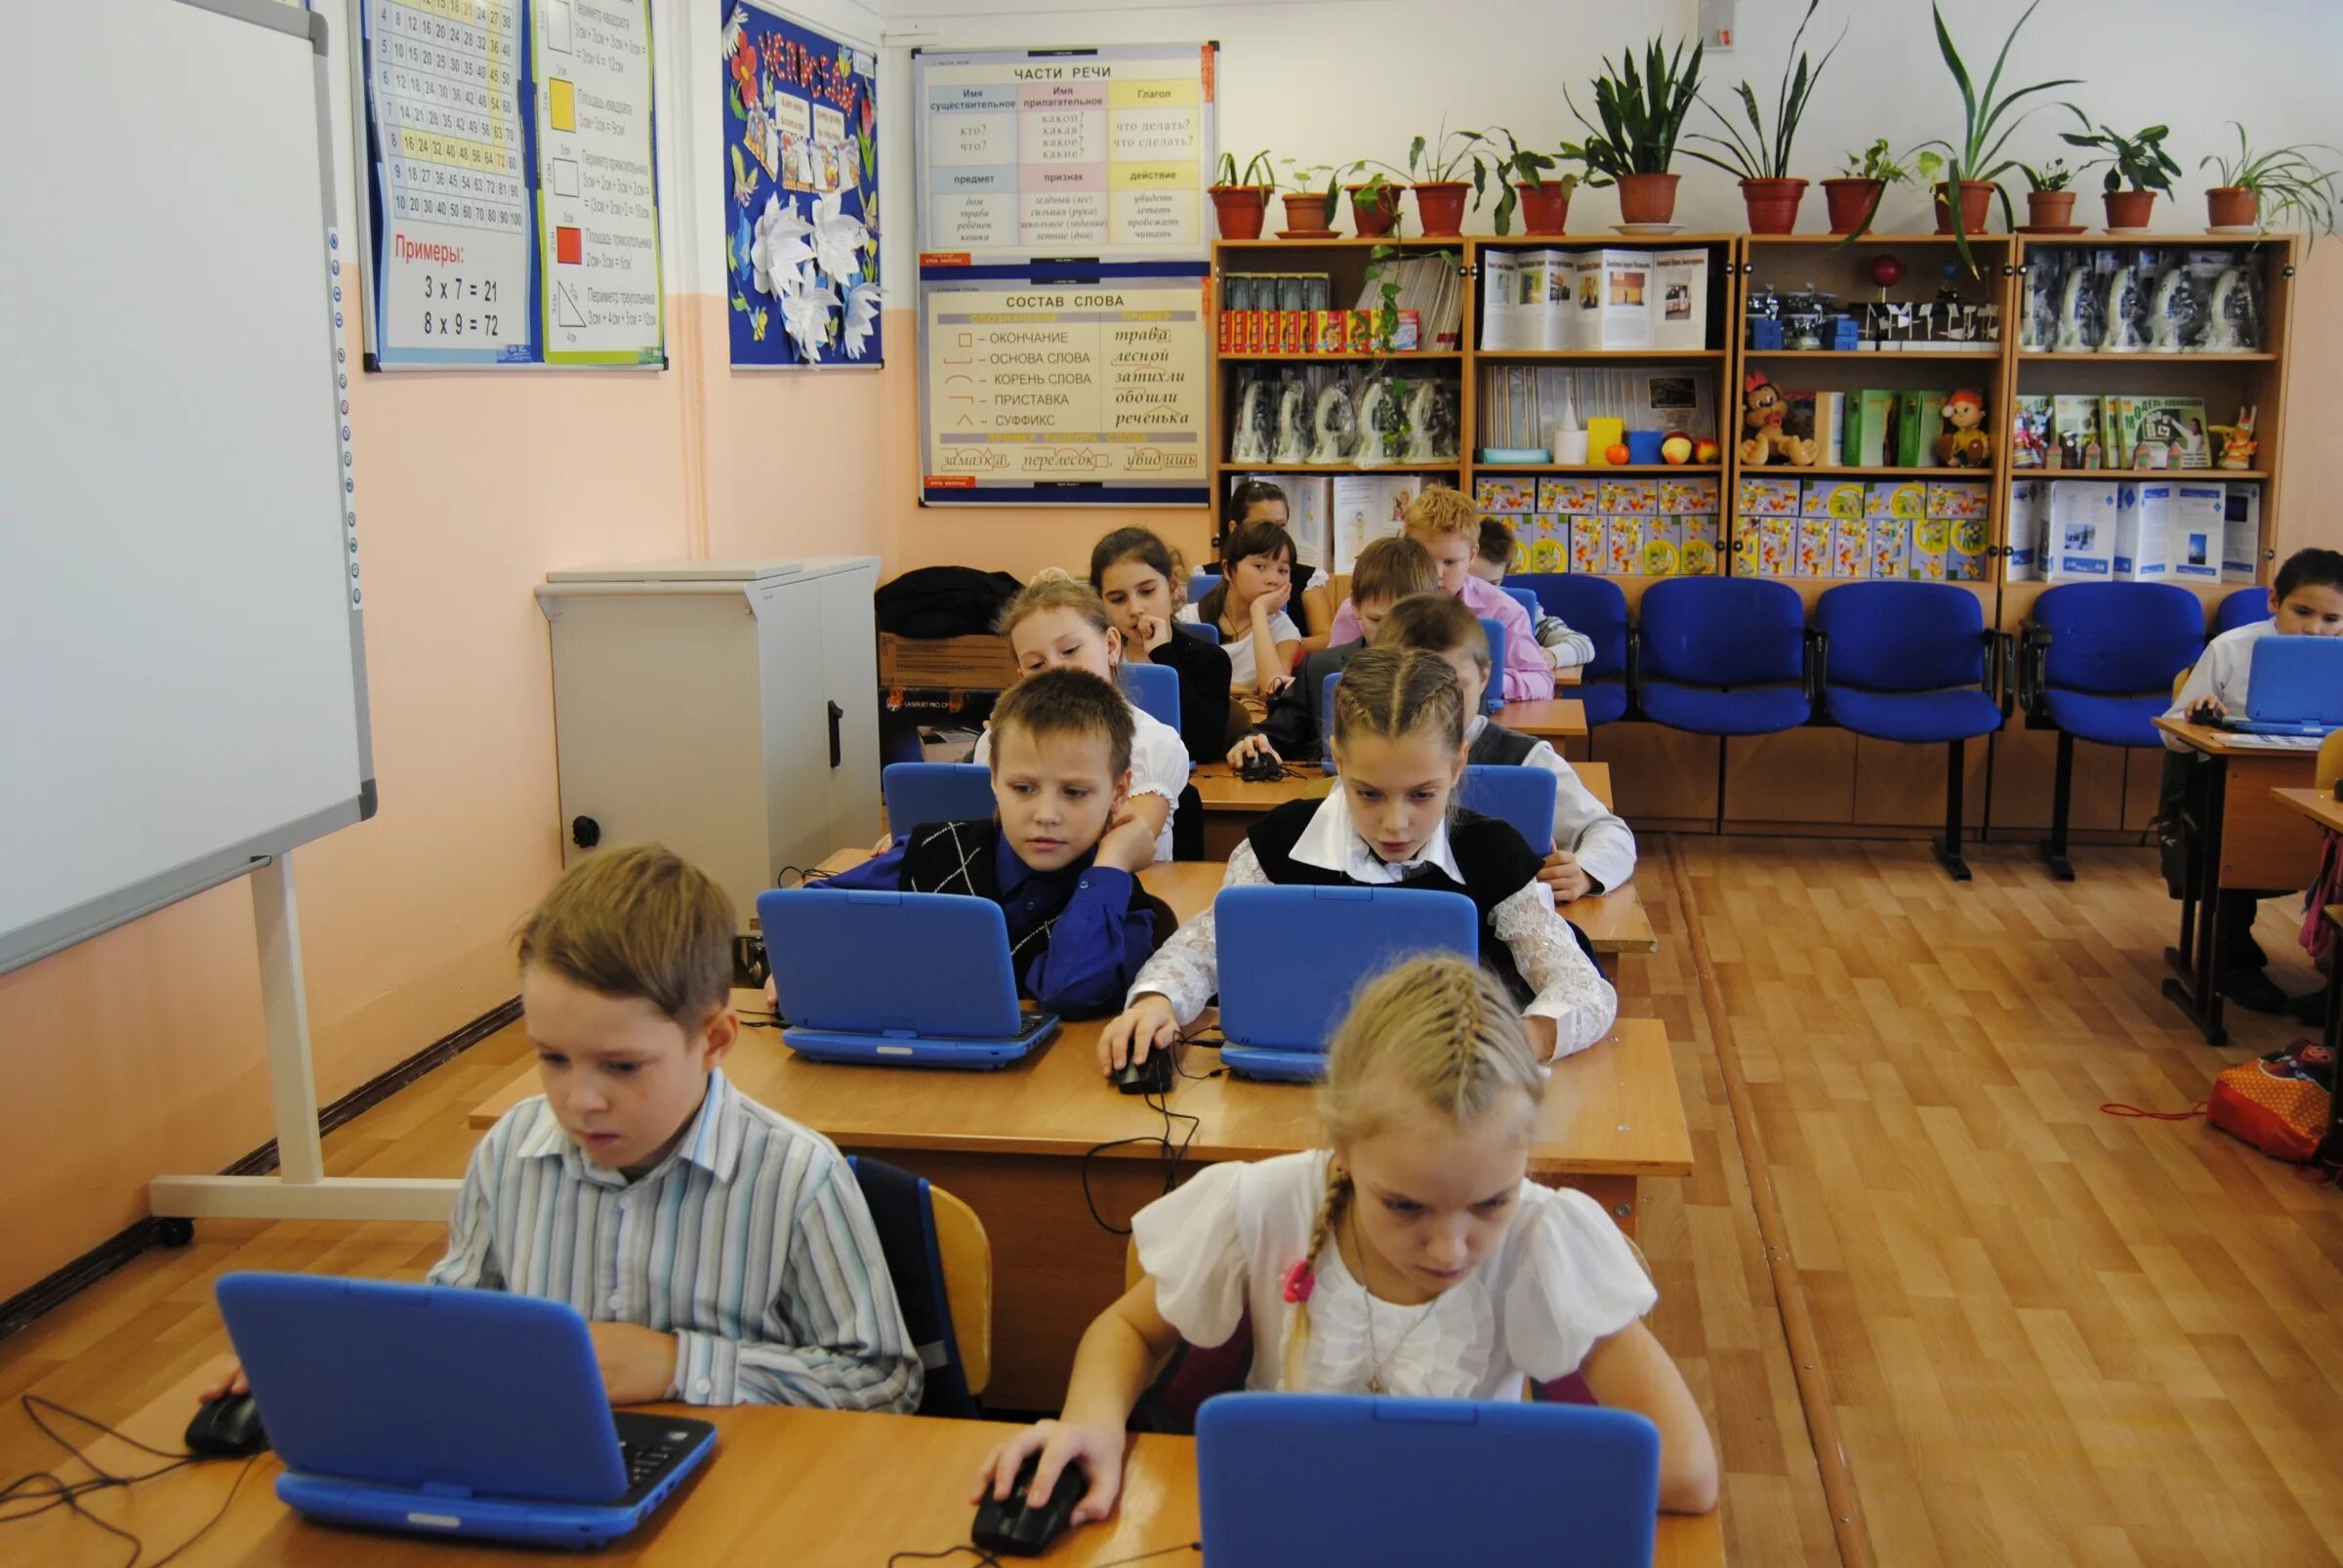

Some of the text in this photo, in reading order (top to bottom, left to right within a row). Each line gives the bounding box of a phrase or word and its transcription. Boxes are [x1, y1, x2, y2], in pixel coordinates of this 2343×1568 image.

[464, 2, 473, 16] 21
[477, 6, 486, 20] 24
[490, 11, 499, 23] 27
[503, 16, 511, 28] 30
[382, 8, 511, 57] 4 8 12 16 20 24 28 32 36 40
[382, 40, 511, 86] 5 10 15 20 25 30 35 40 45 50
[1014, 66, 1111, 80] ЧАСТИ РЕЧИ
[383, 71, 512, 113] 6 12 18 24 30 36 42 48 54 60
[963, 89, 983, 98] Имя
[1052, 86, 1073, 96] Имя
[1137, 90, 1171, 99] Глагол
[930, 100, 1016, 111] существительное
[1023, 99, 1103, 109] прилагательное
[387, 102, 514, 142] 7 14 21 28 35 42 49 56 63 70
[1042, 112, 1086, 123] какой?
[961, 124, 987, 136] кто?
[1043, 124, 1085, 136] какая?
[1117, 119, 1191, 132] что делать?
[961, 141, 987, 152] что?
[1043, 136, 1085, 147] какое?
[1113, 136, 1193, 148] что сделать?
[391, 133, 517, 170] 8 16 24 32 40 48 56 64 72 80
[1042, 148, 1085, 159] какие?
[394, 164, 519, 198] 9 18 27 36 45 54 63 72 81 90
[955, 175, 994, 186] предмет
[1045, 172, 1084, 184] признак
[1130, 171, 1176, 182] действие
[966, 197, 983, 206] дом
[396, 195, 522, 226] 10 20 30 40 50 60 70 80 90 100
[961, 210, 989, 219] трава
[395, 234, 464, 264] Примеры:
[425, 275, 432, 299] 3
[455, 277, 463, 301] 7
[471, 285, 477, 296] =
[484, 279, 498, 302] 21
[1007, 296, 1125, 308] СОСТАВ СЛОВА
[425, 311, 432, 334] 8
[455, 312, 463, 334] 9
[471, 320, 477, 330] =
[484, 314, 498, 337] 72
[990, 332, 1068, 344] ОКОНЧАНИЕ
[1115, 328, 1169, 344] трава
[990, 352, 1090, 365] ОСНОВА СЛОВА
[1115, 350, 1170, 361] лесной
[994, 374, 1091, 386] КОРЕНЬ СЛОВА
[1115, 371, 1185, 383] затихли
[995, 394, 1069, 406] ПРИСТАВКА
[1115, 391, 1177, 404] обошли
[995, 415, 1055, 427] СУФФИКС
[1115, 412, 1189, 428] реченька
[1127, 454, 1197, 469] увидишь
